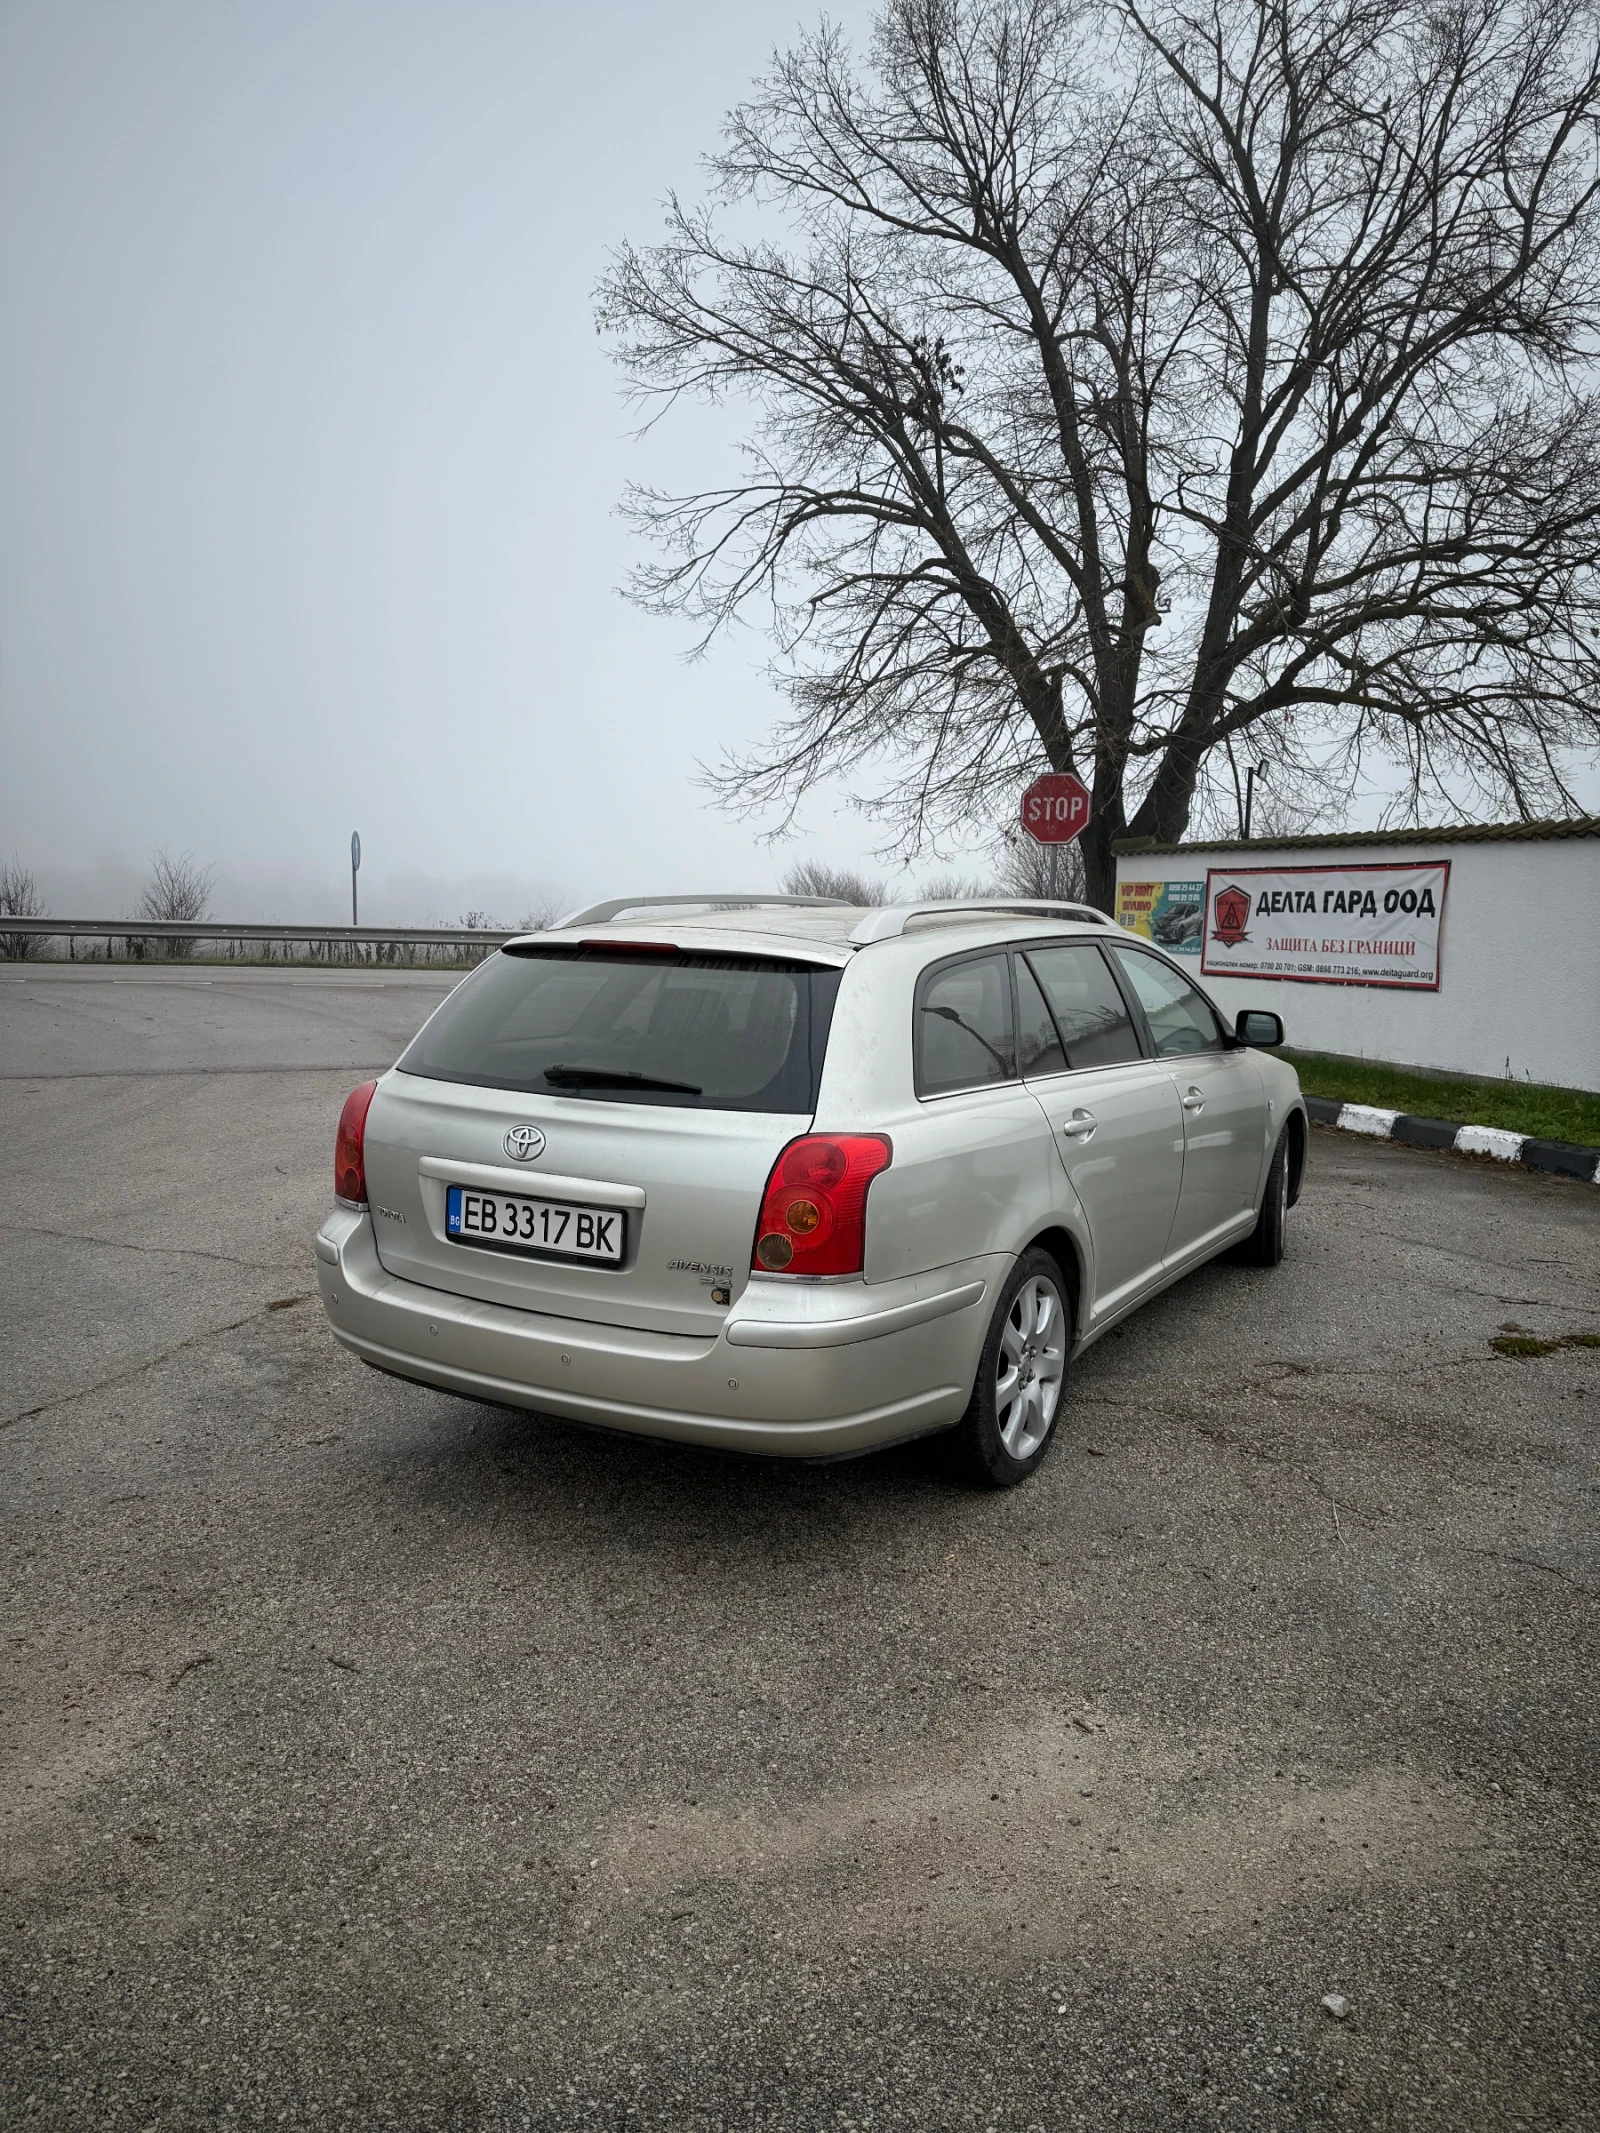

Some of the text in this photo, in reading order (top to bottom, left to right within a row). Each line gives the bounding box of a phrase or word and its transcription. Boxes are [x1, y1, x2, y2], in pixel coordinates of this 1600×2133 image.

[1028, 796, 1083, 821] STOP
[1121, 885, 1155, 897] VIP RENT
[1186, 893, 1193, 901] 11
[1188, 884, 1196, 892] 44
[1195, 884, 1203, 892] 27
[1256, 888, 1435, 918] ДЕЛТА ГАРД ООД
[1265, 937, 1416, 957] ЗАЩИТА БЕЗ ГРАНИЦИ
[1206, 960, 1434, 981] национален номер: 0700 20 701; GSM: 0898 773 216; www.deltaguard.org
[450, 1215, 460, 1226] BG
[465, 1196, 615, 1252] EB 3317 BK
[667, 1260, 733, 1277] AVENSIS
